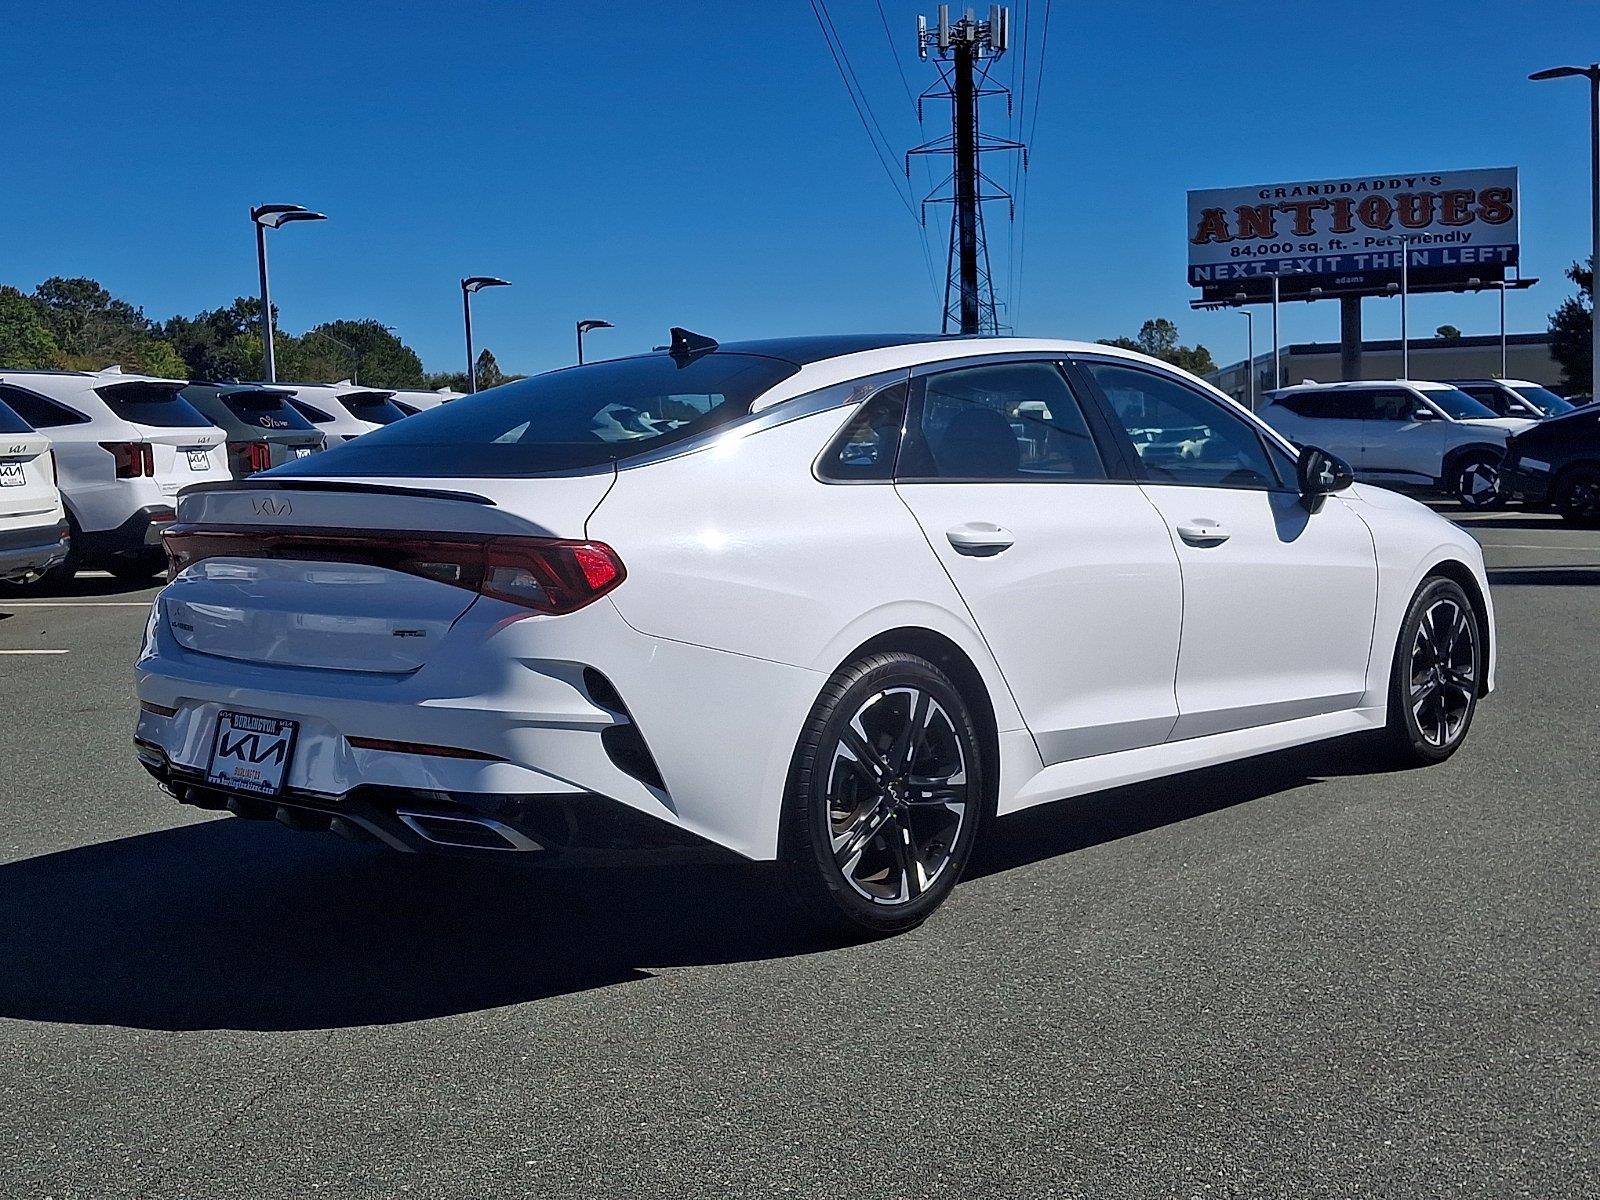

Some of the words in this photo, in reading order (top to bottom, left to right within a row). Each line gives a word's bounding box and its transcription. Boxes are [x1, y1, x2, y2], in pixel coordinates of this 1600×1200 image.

[1258, 176, 1442, 199] GRANDDADDY'S
[1190, 187, 1514, 245] ANTIQUES
[1230, 242, 1293, 258] 84,000
[1298, 242, 1323, 254] sq.
[1328, 239, 1347, 250] ft.
[1194, 262, 1266, 281] NEXT
[1278, 257, 1341, 276] EXIT
[1354, 251, 1429, 270] THEN
[1442, 247, 1512, 264] LEFT
[234, 714, 277, 733] BURLINGTON
[219, 730, 287, 767] KIA
